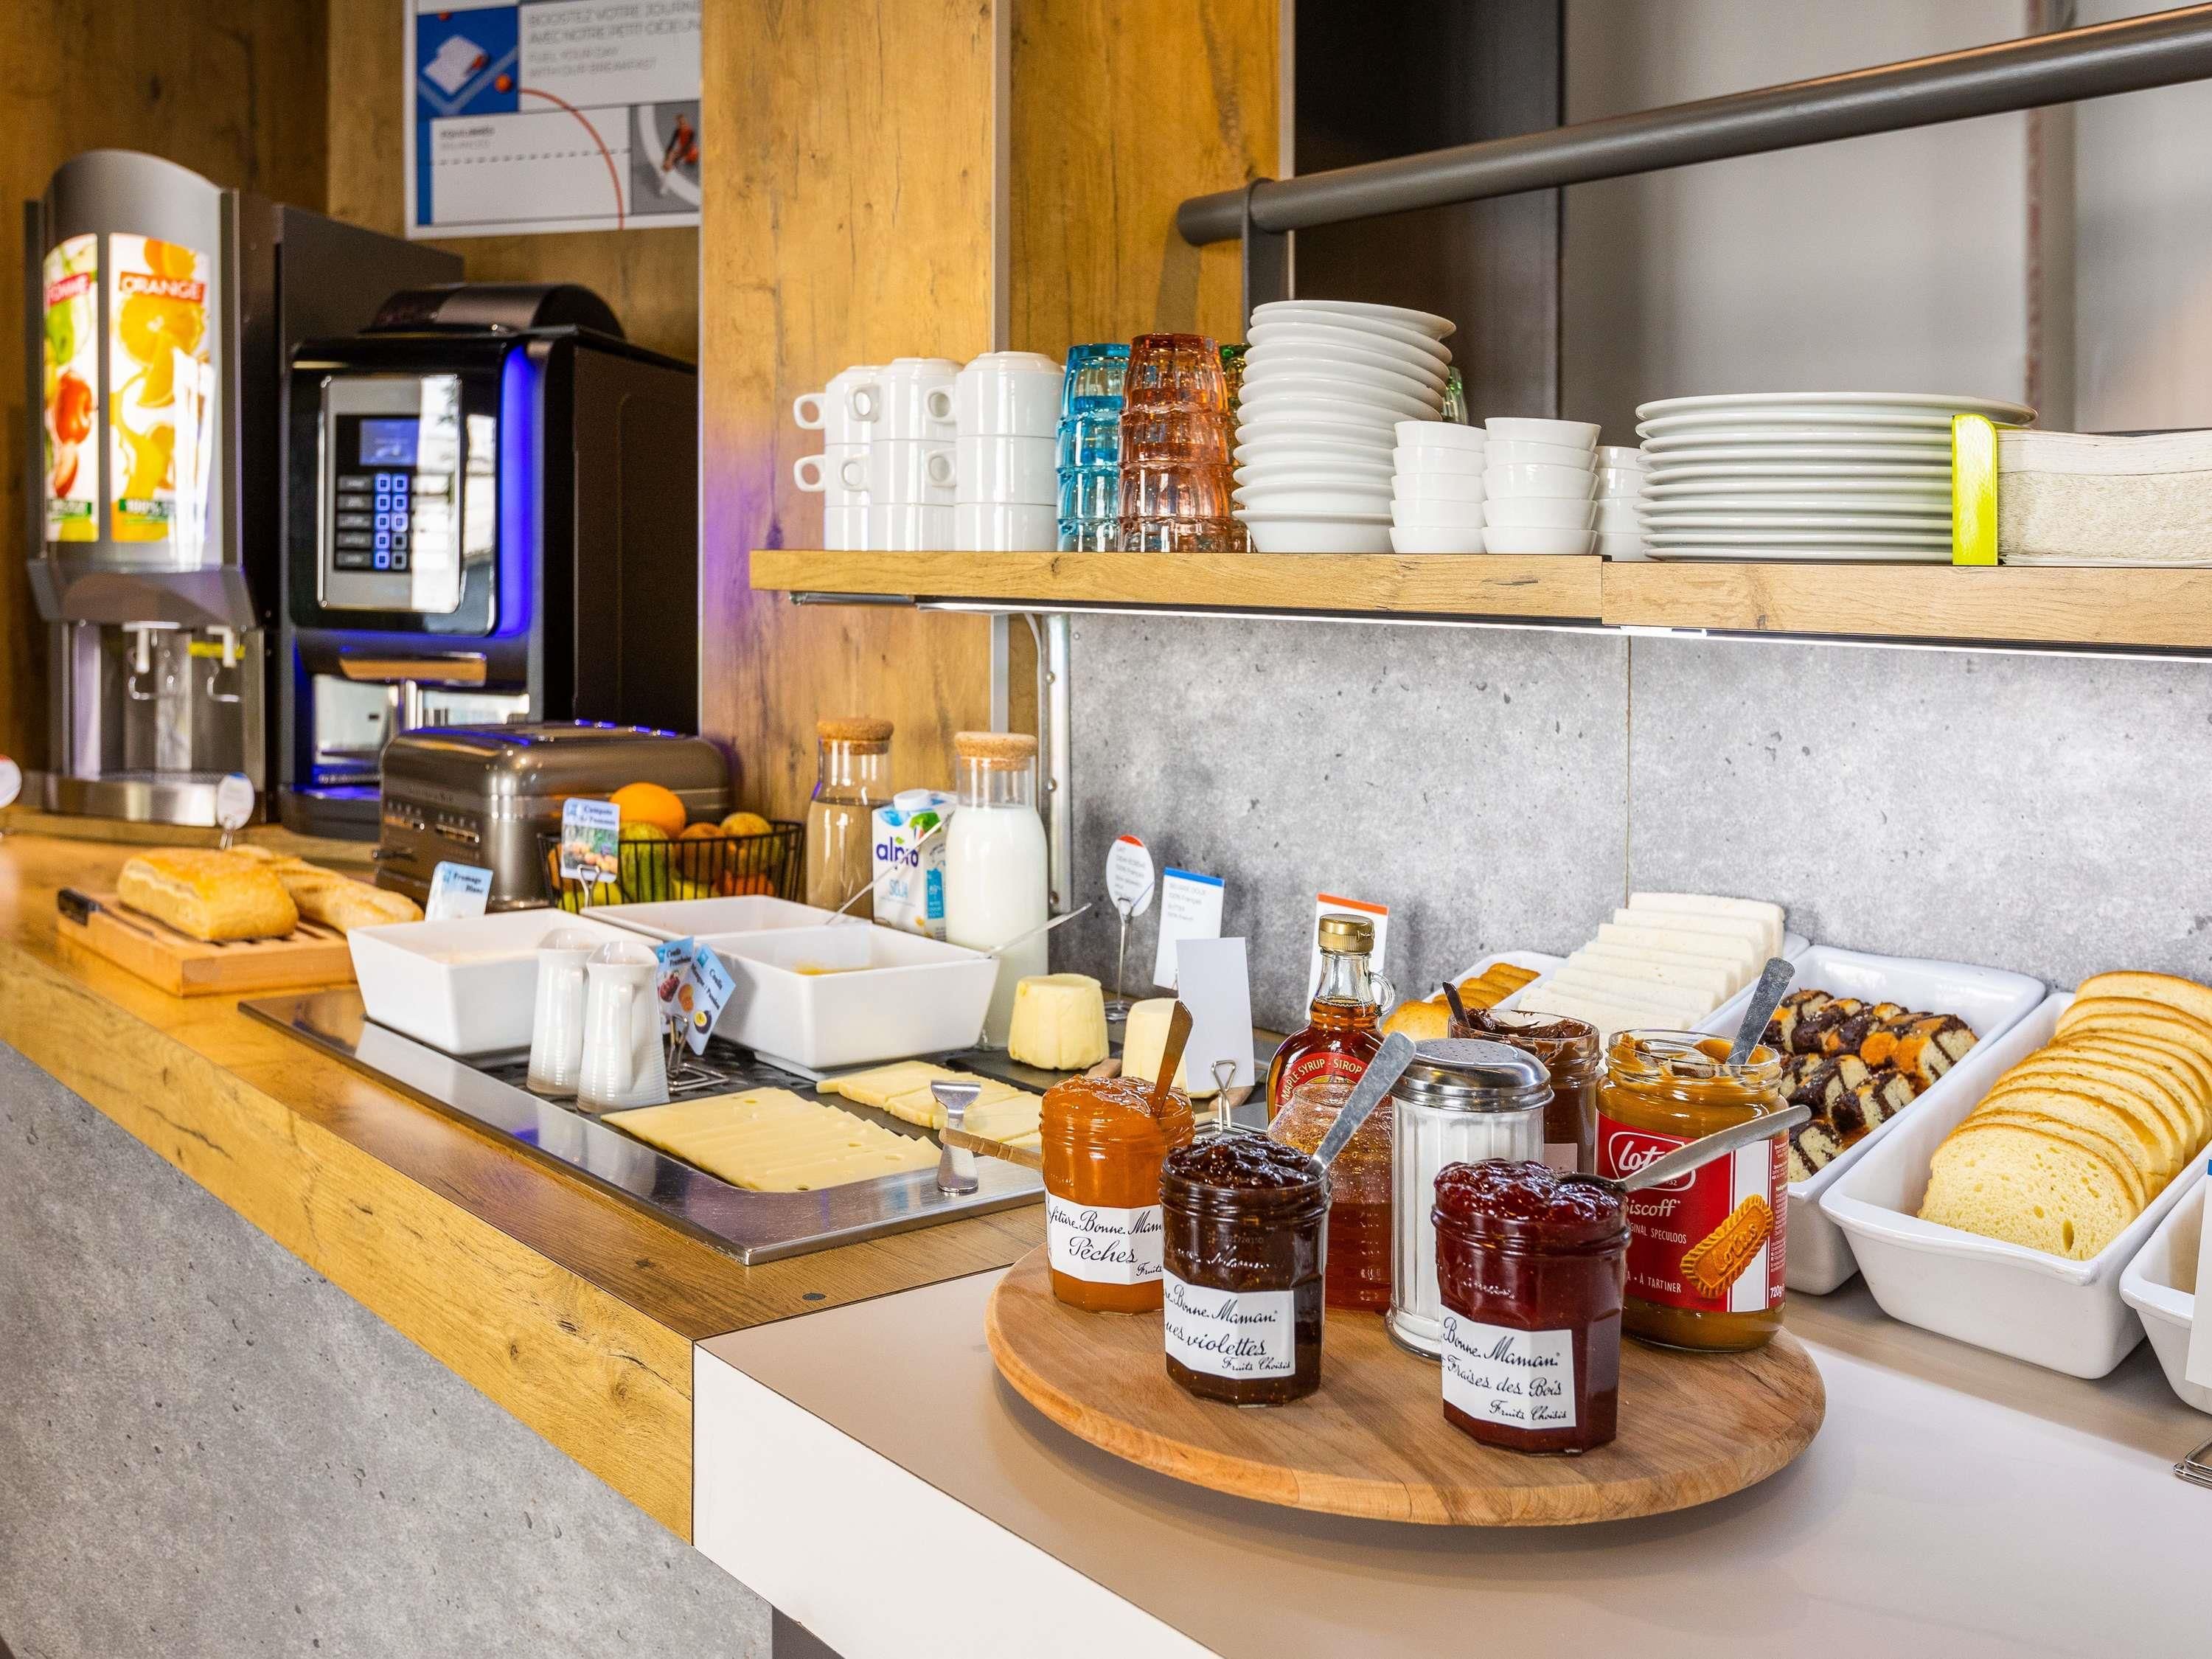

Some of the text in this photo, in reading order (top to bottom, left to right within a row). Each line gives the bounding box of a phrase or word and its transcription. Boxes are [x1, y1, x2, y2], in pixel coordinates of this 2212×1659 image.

[122, 276, 203, 299] ORANGE
[1281, 1071, 1300, 1101] MAPLE
[1298, 1058, 1326, 1076] SYRUP
[1333, 1058, 1363, 1074] SIROP
[1619, 1141, 1666, 1171] Lot
[1048, 1206, 1162, 1235] fiture Bonne Mam
[1068, 1236, 1138, 1263] Pêches
[1651, 1228, 1687, 1245] SPECULOOS
[1648, 1276, 1681, 1293] TARTINER
[1173, 1283, 1210, 1318] Bonne
[1211, 1299, 1276, 1324] Maman
[1186, 1333, 1267, 1357] violettes
[1443, 1317, 1559, 1368] Bonne Maman
[1222, 1356, 1290, 1371] Fruits Choisis
[1447, 1354, 1562, 1397] Fraises des Bois
[1489, 1399, 1567, 1421] Fruits Choisis
